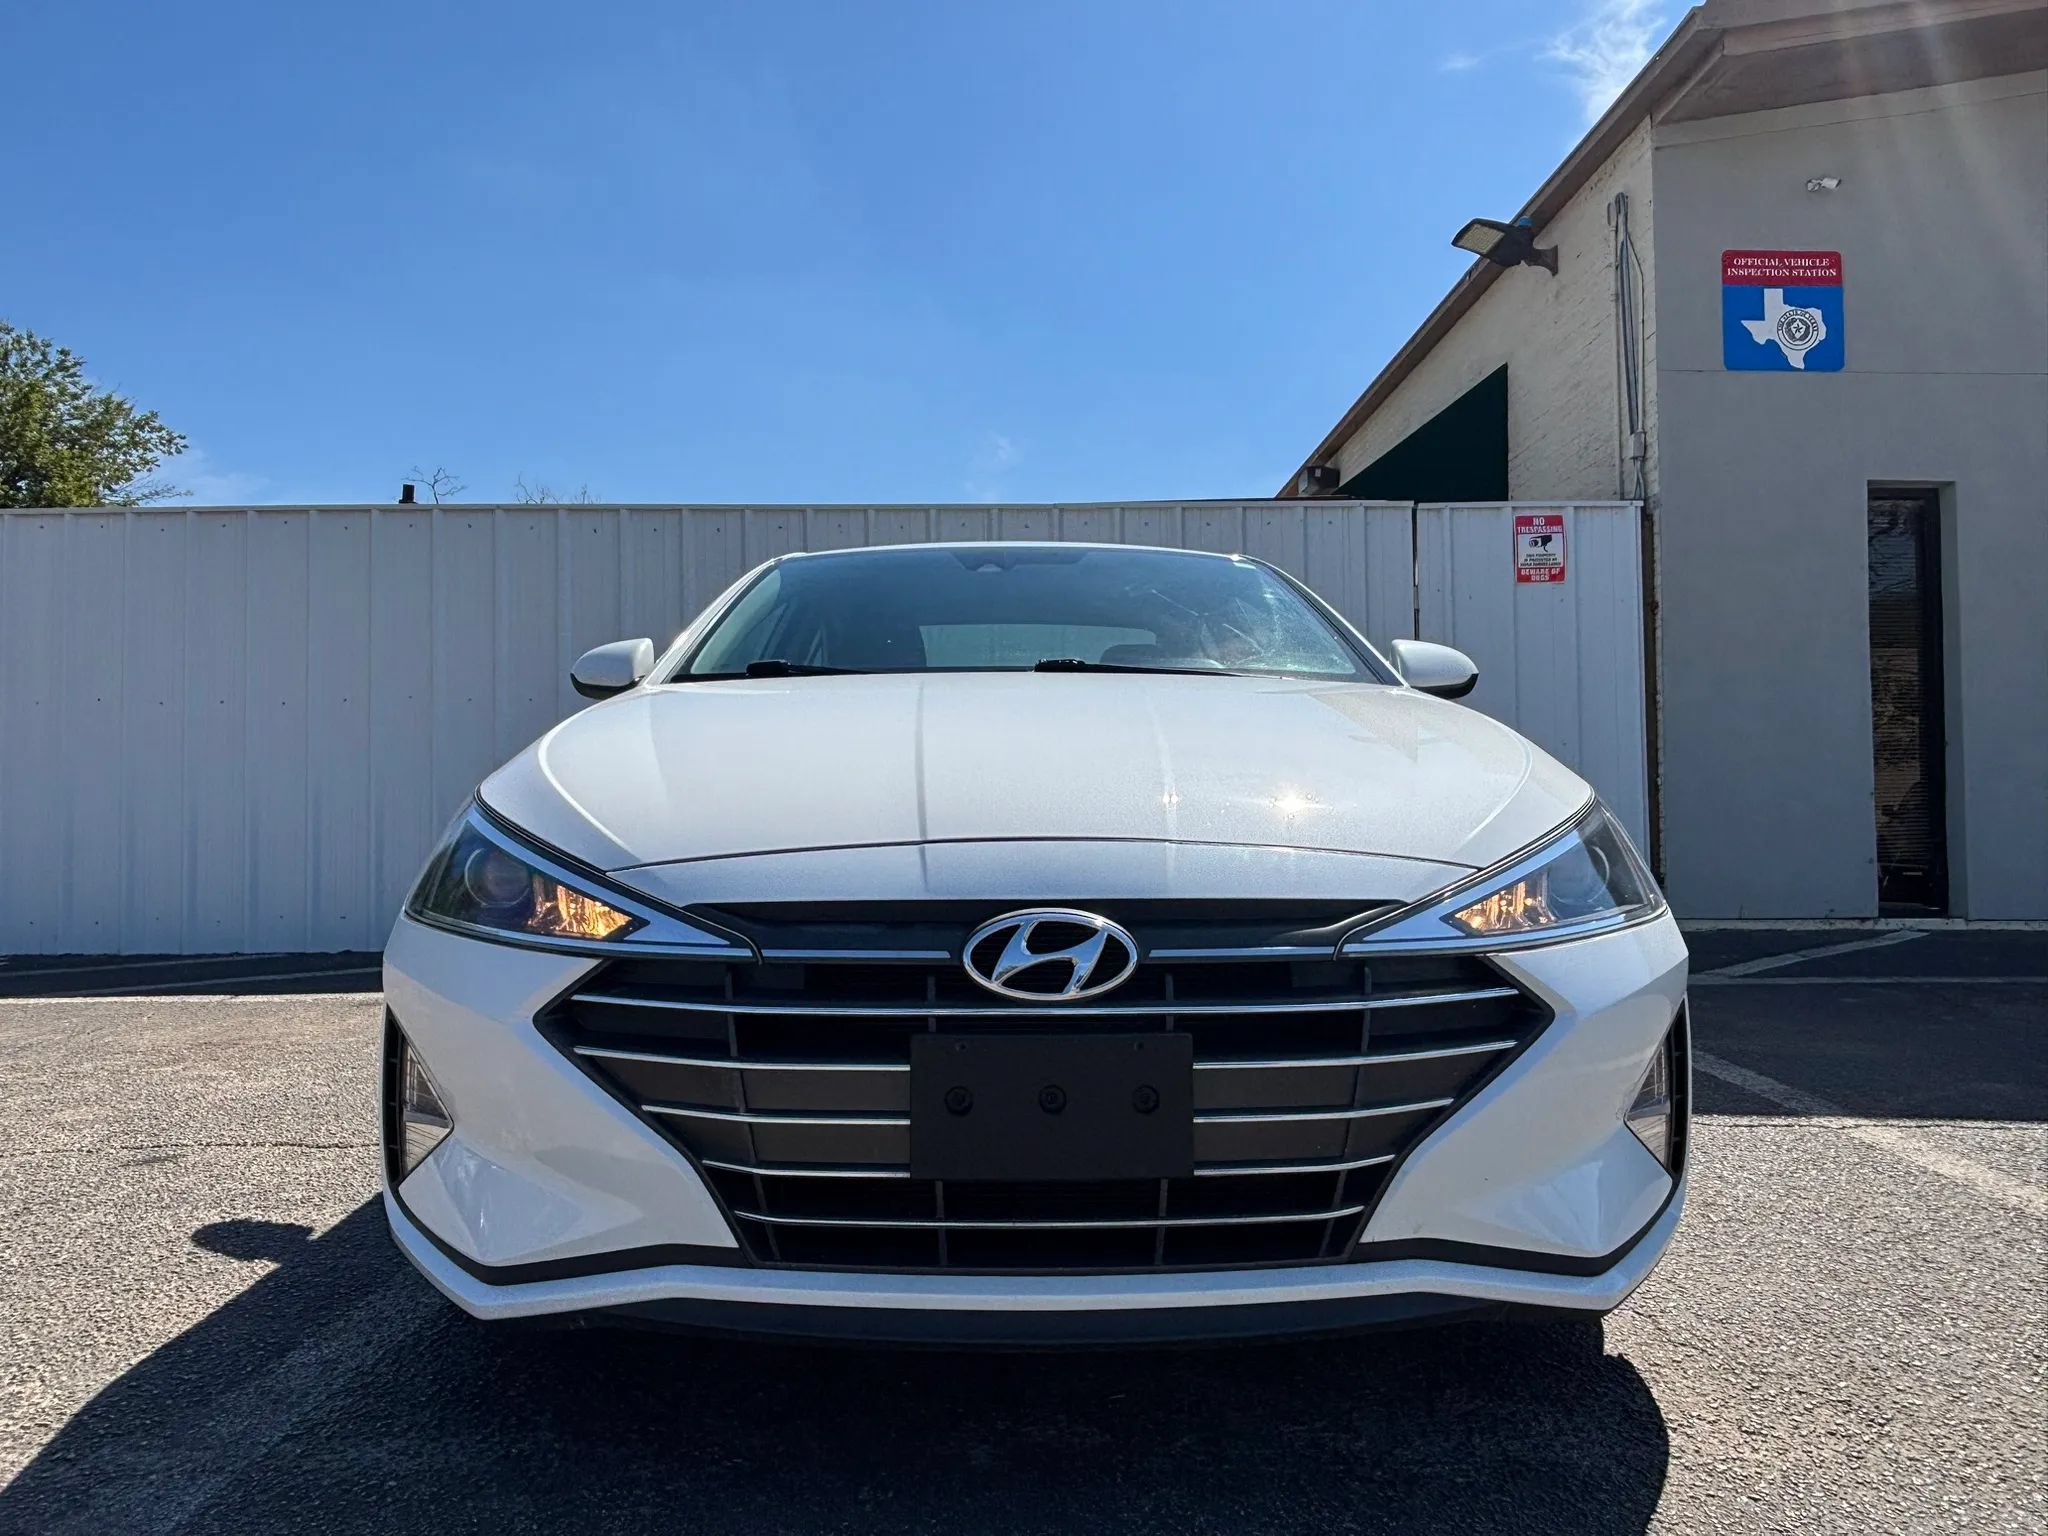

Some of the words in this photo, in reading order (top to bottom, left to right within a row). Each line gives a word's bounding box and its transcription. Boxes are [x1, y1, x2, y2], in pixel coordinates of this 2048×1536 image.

[1733, 257, 1781, 267] OFFICIAL
[1783, 258, 1830, 267] VEHICLE
[1727, 267, 1790, 277] INSPECTION
[1791, 268, 1837, 277] STATION
[1533, 517, 1545, 525] NO
